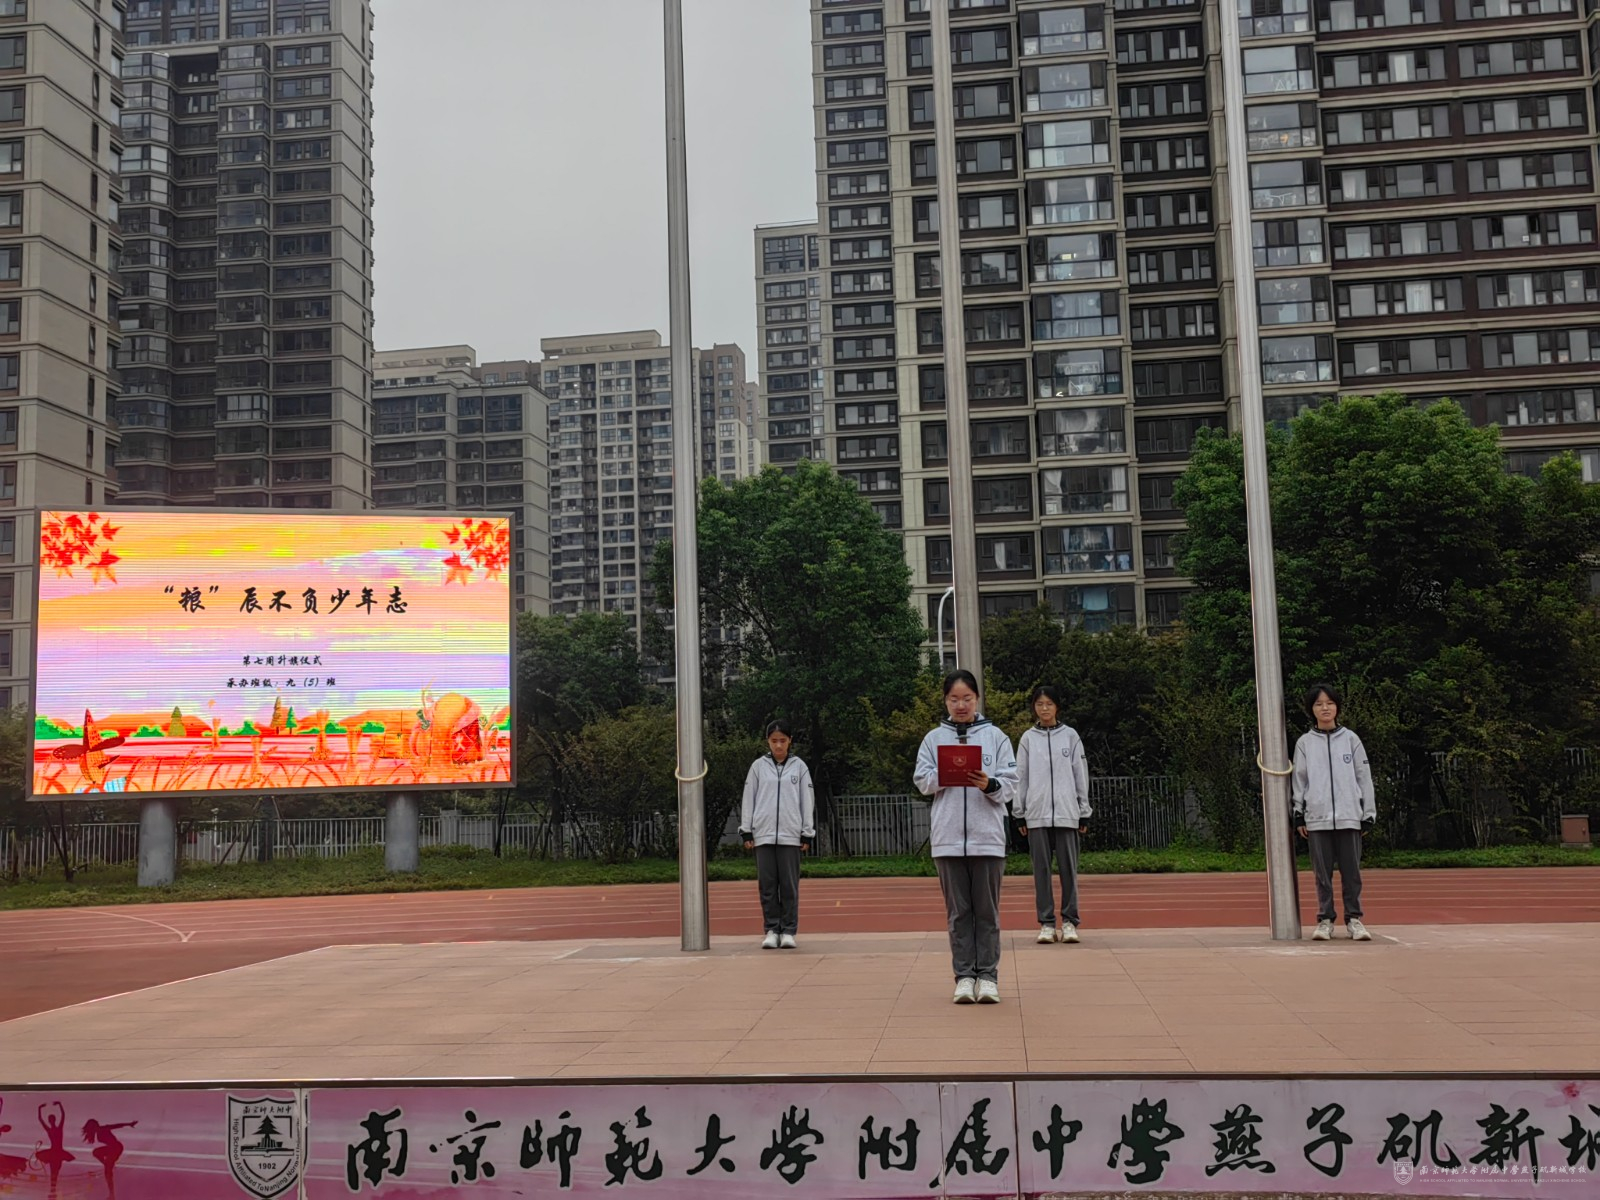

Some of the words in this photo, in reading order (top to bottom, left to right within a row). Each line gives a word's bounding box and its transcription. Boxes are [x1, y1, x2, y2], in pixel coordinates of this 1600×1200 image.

[242, 654, 323, 667] 第七周升旗仪式
[232, 1119, 240, 1135] High
